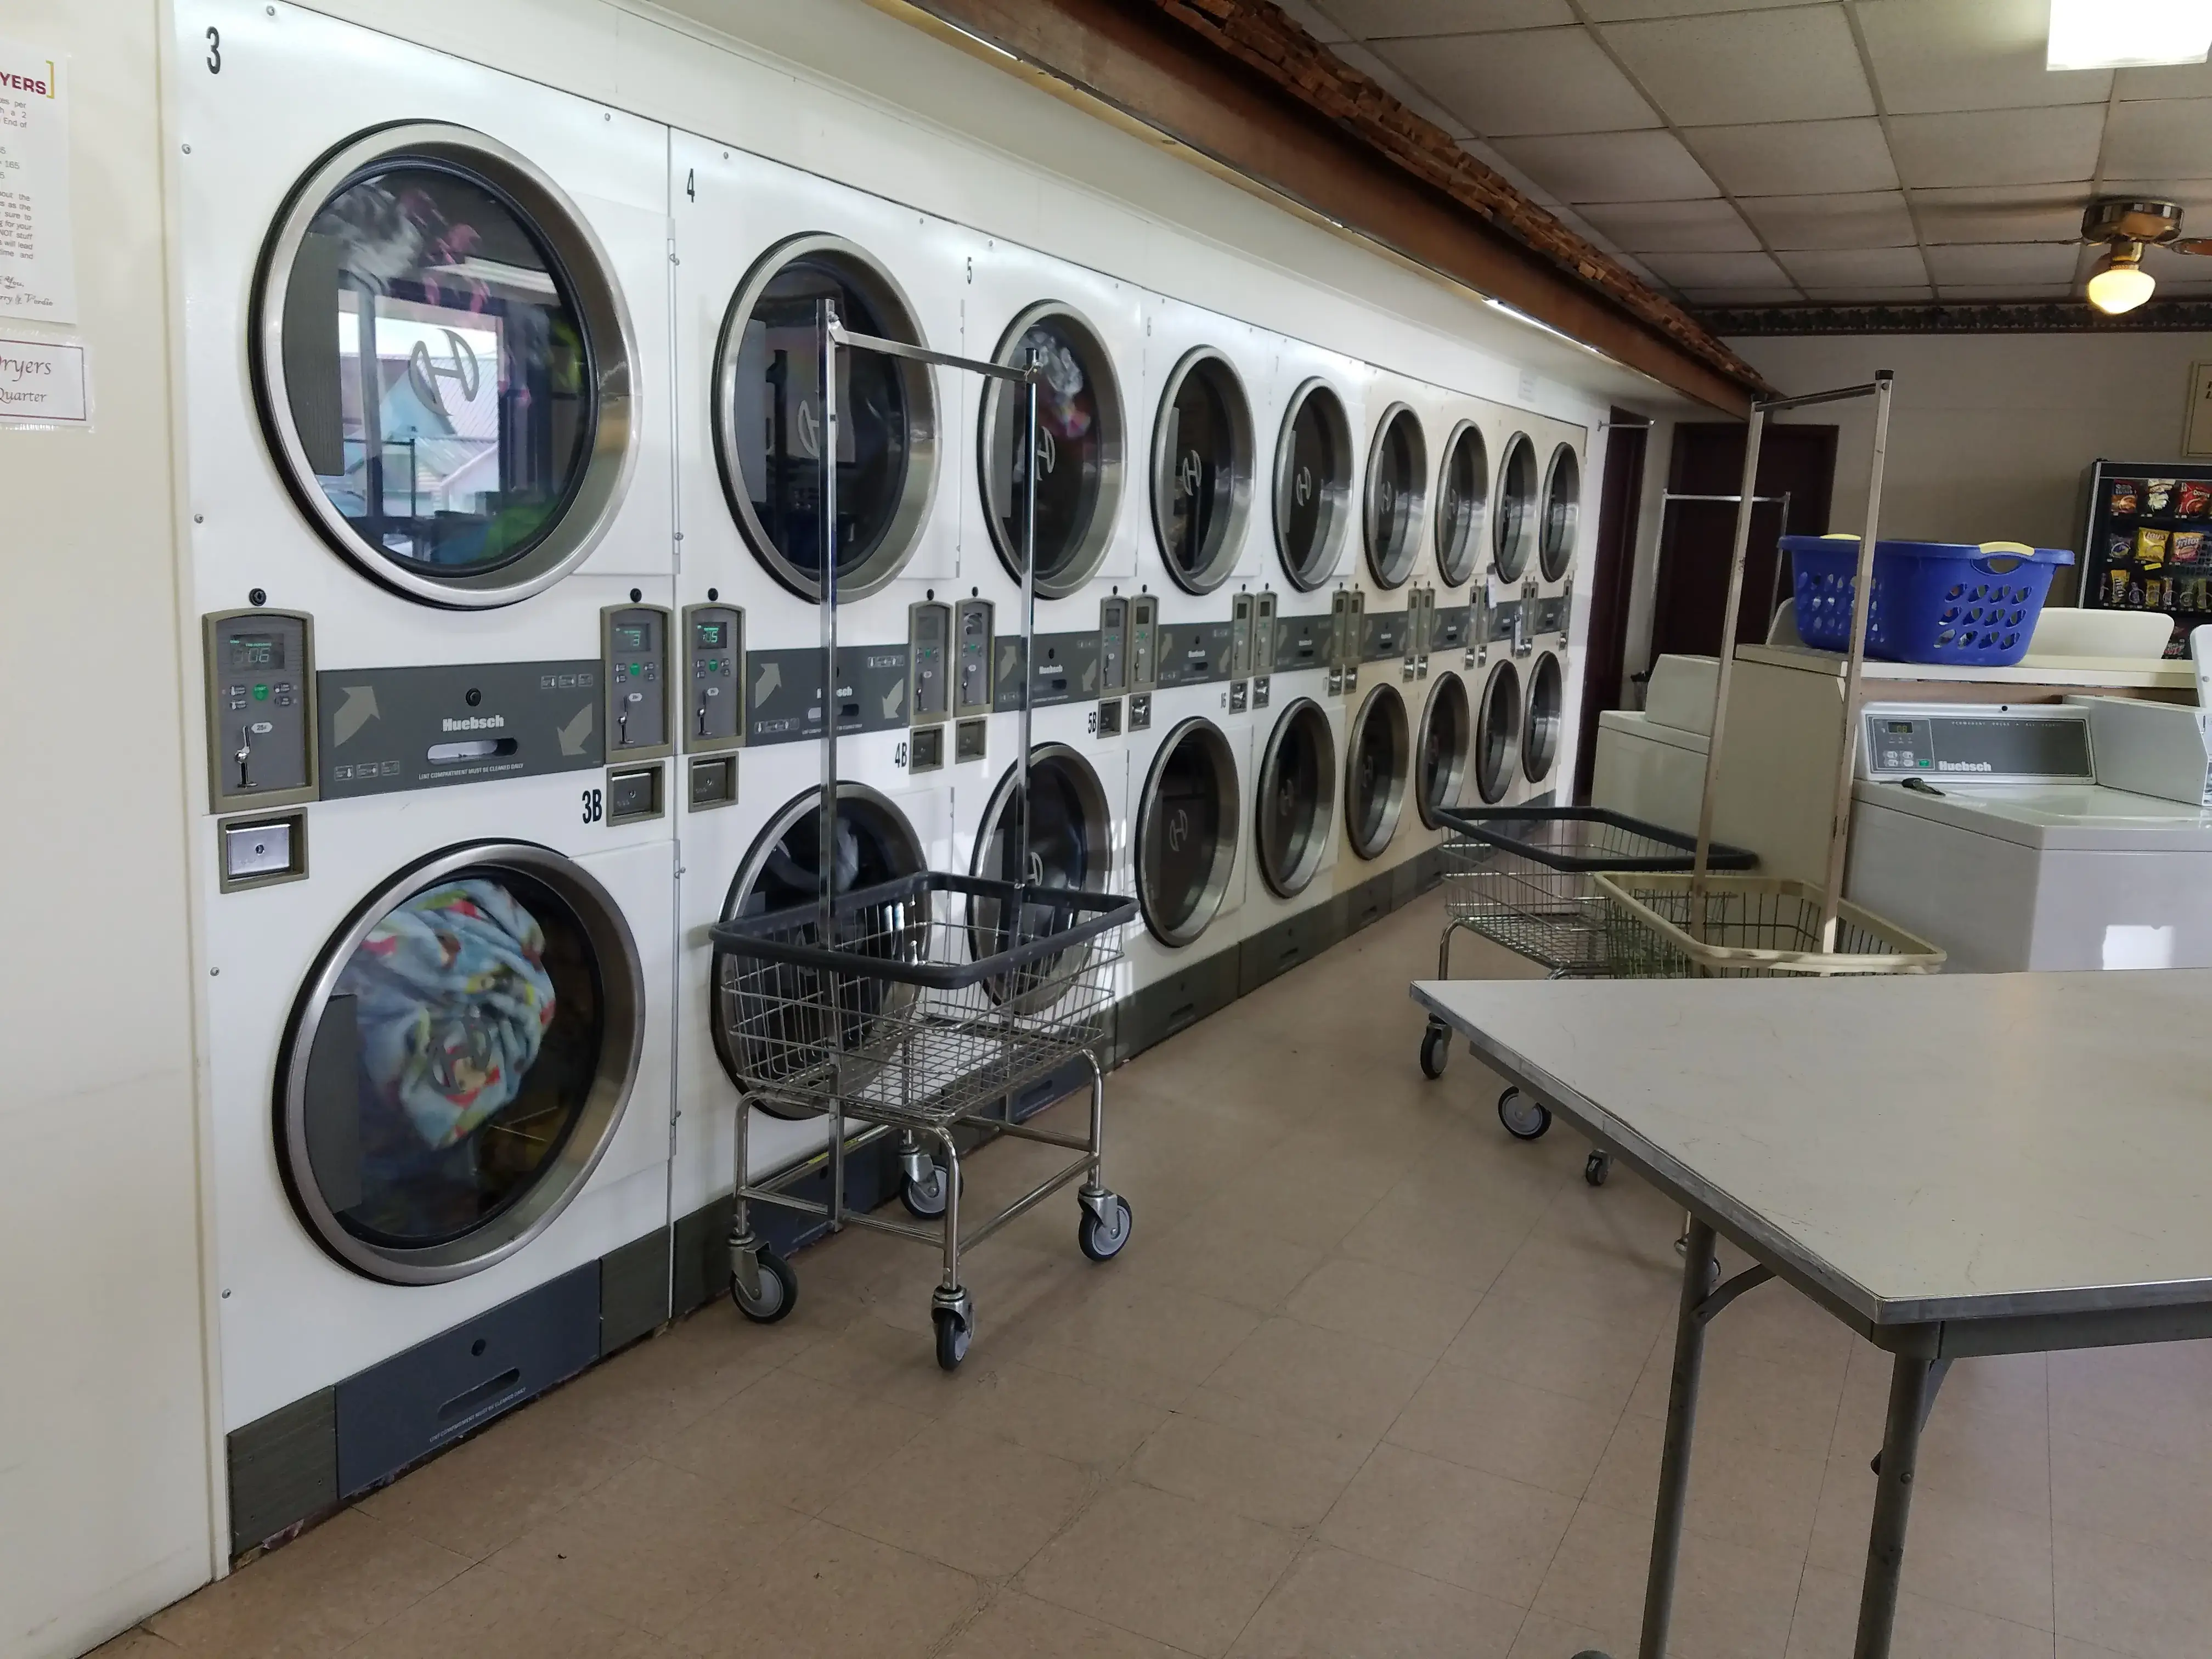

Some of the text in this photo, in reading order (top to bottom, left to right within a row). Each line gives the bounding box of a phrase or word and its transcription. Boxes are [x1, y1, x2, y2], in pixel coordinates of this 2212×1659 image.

[206, 26, 221, 75] 3
[0, 71, 46, 95] YERS
[15, 101, 26, 109] per
[3, 117, 18, 127] End
[5, 160, 20, 170] 165
[687, 168, 695, 203] 4
[19, 193, 31, 201] the
[18, 241, 33, 250] lead
[967, 256, 972, 285] 5
[0, 356, 52, 382] ryers
[442, 715, 504, 732] Huebsch
[1088, 712, 1097, 734] 5B
[895, 742, 907, 768] 4B
[431, 769, 468, 779] COMPARTMENT
[1938, 759, 1992, 772] Huebsch
[582, 788, 602, 824] 3B
